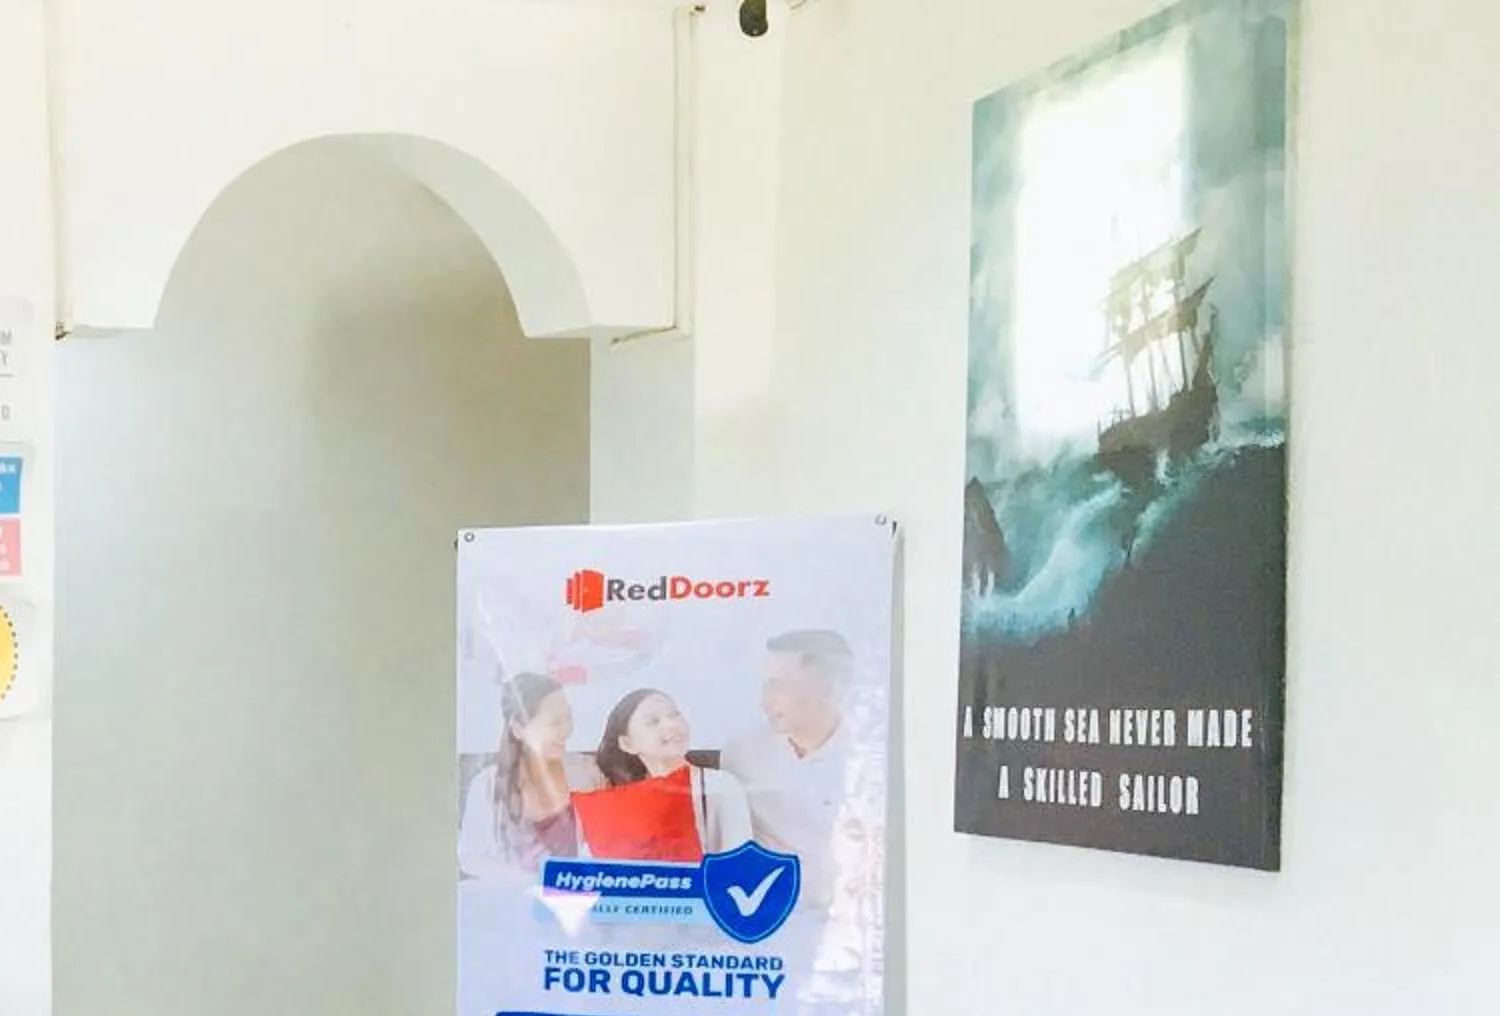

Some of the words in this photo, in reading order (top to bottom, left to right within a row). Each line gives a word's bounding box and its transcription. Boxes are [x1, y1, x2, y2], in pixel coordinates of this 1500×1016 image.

[606, 575, 771, 601] RedDoorz
[983, 705, 1056, 742] SMOOTH
[1063, 707, 1101, 744] SEA
[1109, 708, 1176, 746] NEVER
[1187, 708, 1253, 747] MADE
[997, 765, 1010, 799] A
[1023, 766, 1103, 808] SKILLED
[1118, 772, 1200, 815] SAILOR
[555, 871, 693, 891] HygienePass
[544, 949, 580, 965] THE
[584, 951, 667, 968] GOLDEN
[670, 953, 784, 971] STANDARD
[544, 966, 612, 994] FOR
[620, 969, 786, 999] QUALITY
